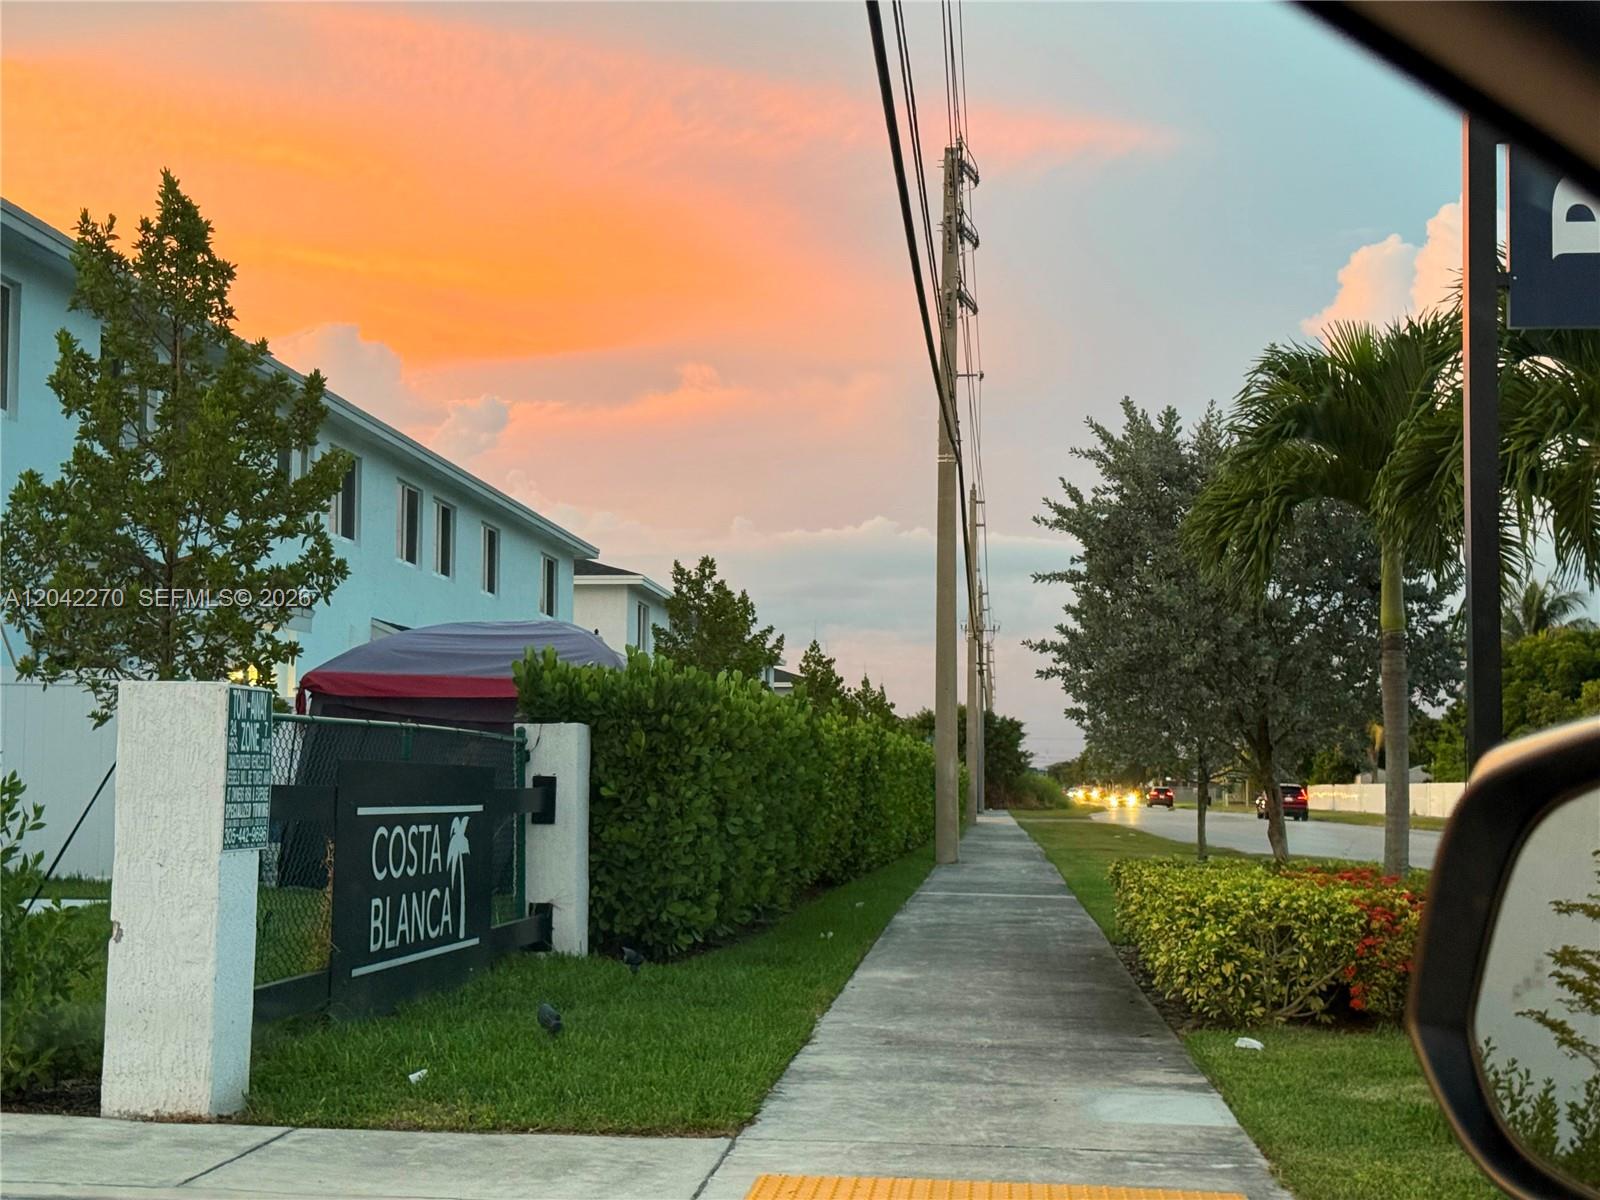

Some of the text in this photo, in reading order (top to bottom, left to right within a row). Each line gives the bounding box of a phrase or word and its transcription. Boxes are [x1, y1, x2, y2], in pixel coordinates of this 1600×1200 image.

[233, 690, 268, 720] TOW-AWAY
[230, 720, 237, 735] 24
[241, 721, 260, 752] ZONE
[264, 721, 269, 737] 7
[371, 824, 442, 881] COSTA
[369, 886, 453, 953] BLANCA
